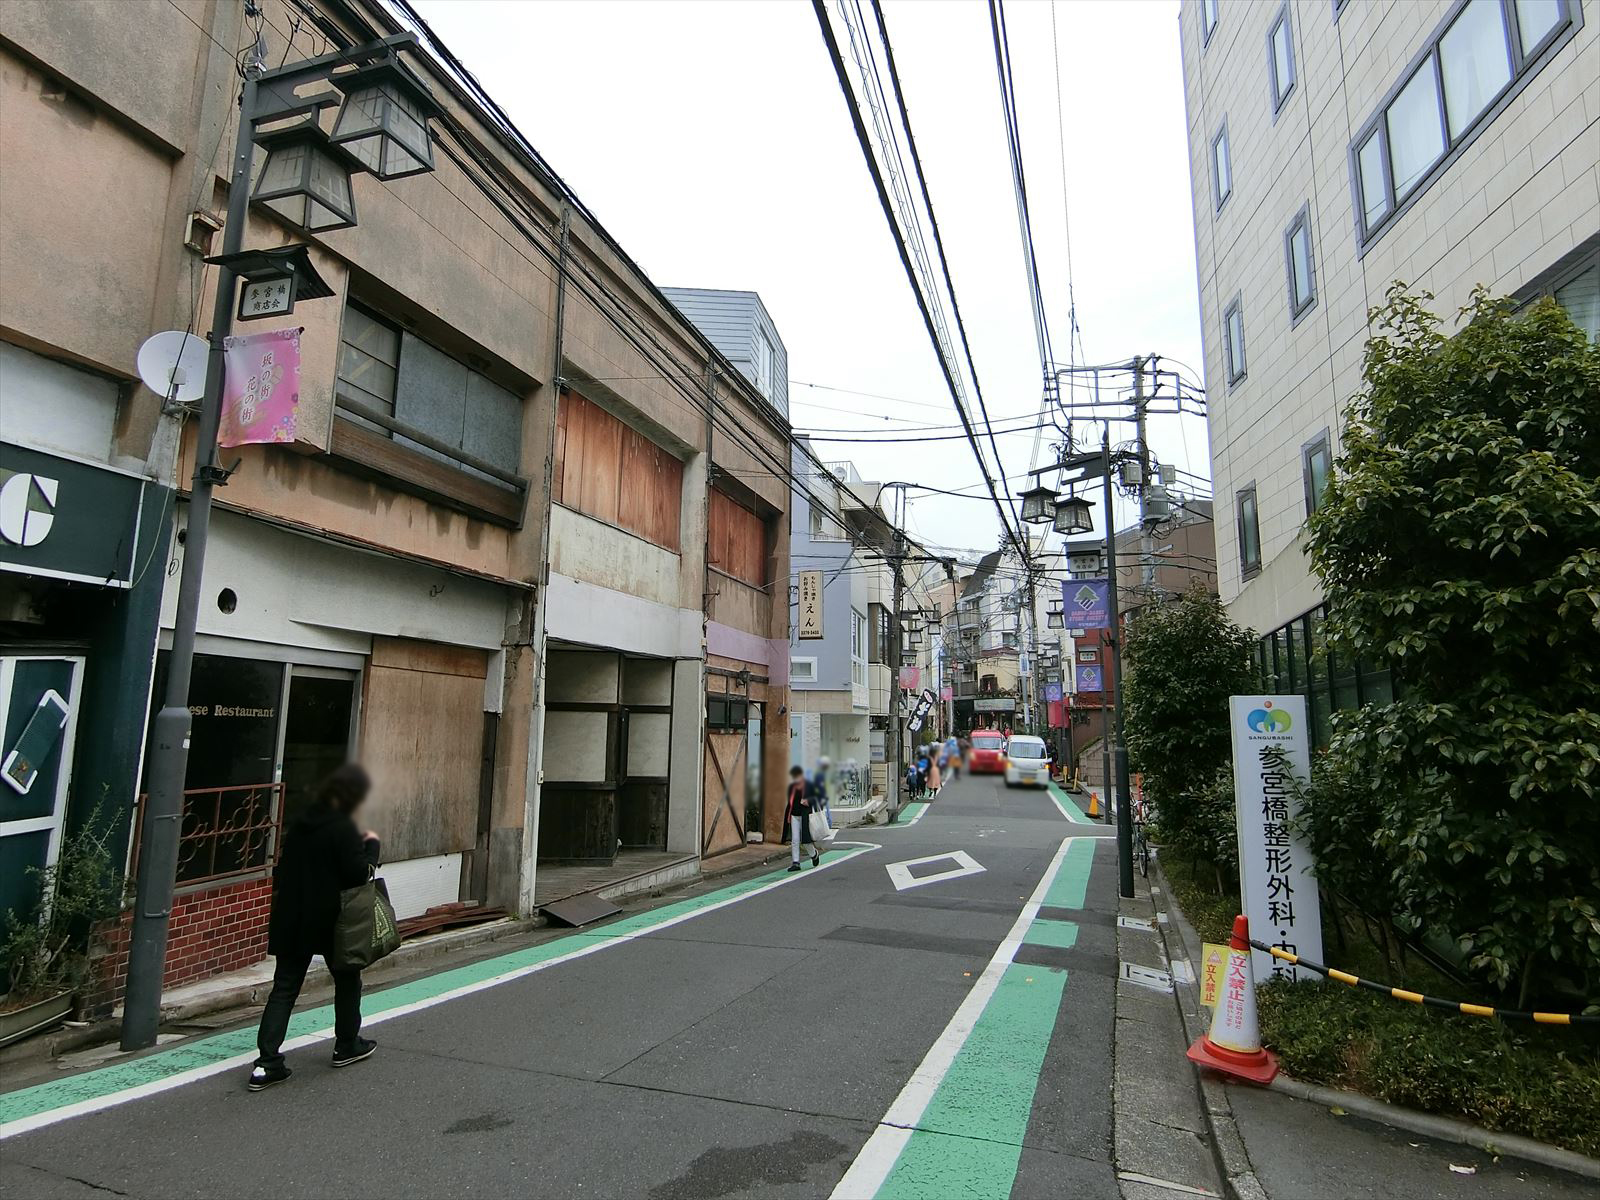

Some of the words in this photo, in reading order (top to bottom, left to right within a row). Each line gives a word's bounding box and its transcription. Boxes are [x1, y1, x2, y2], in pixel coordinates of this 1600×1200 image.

[242, 376, 256, 422] 花の街
[805, 603, 815, 627] えん
[214, 704, 274, 718] Restaurant
[1205, 964, 1216, 1002] 立入禁止
[1228, 955, 1247, 1002] 立入禁止
